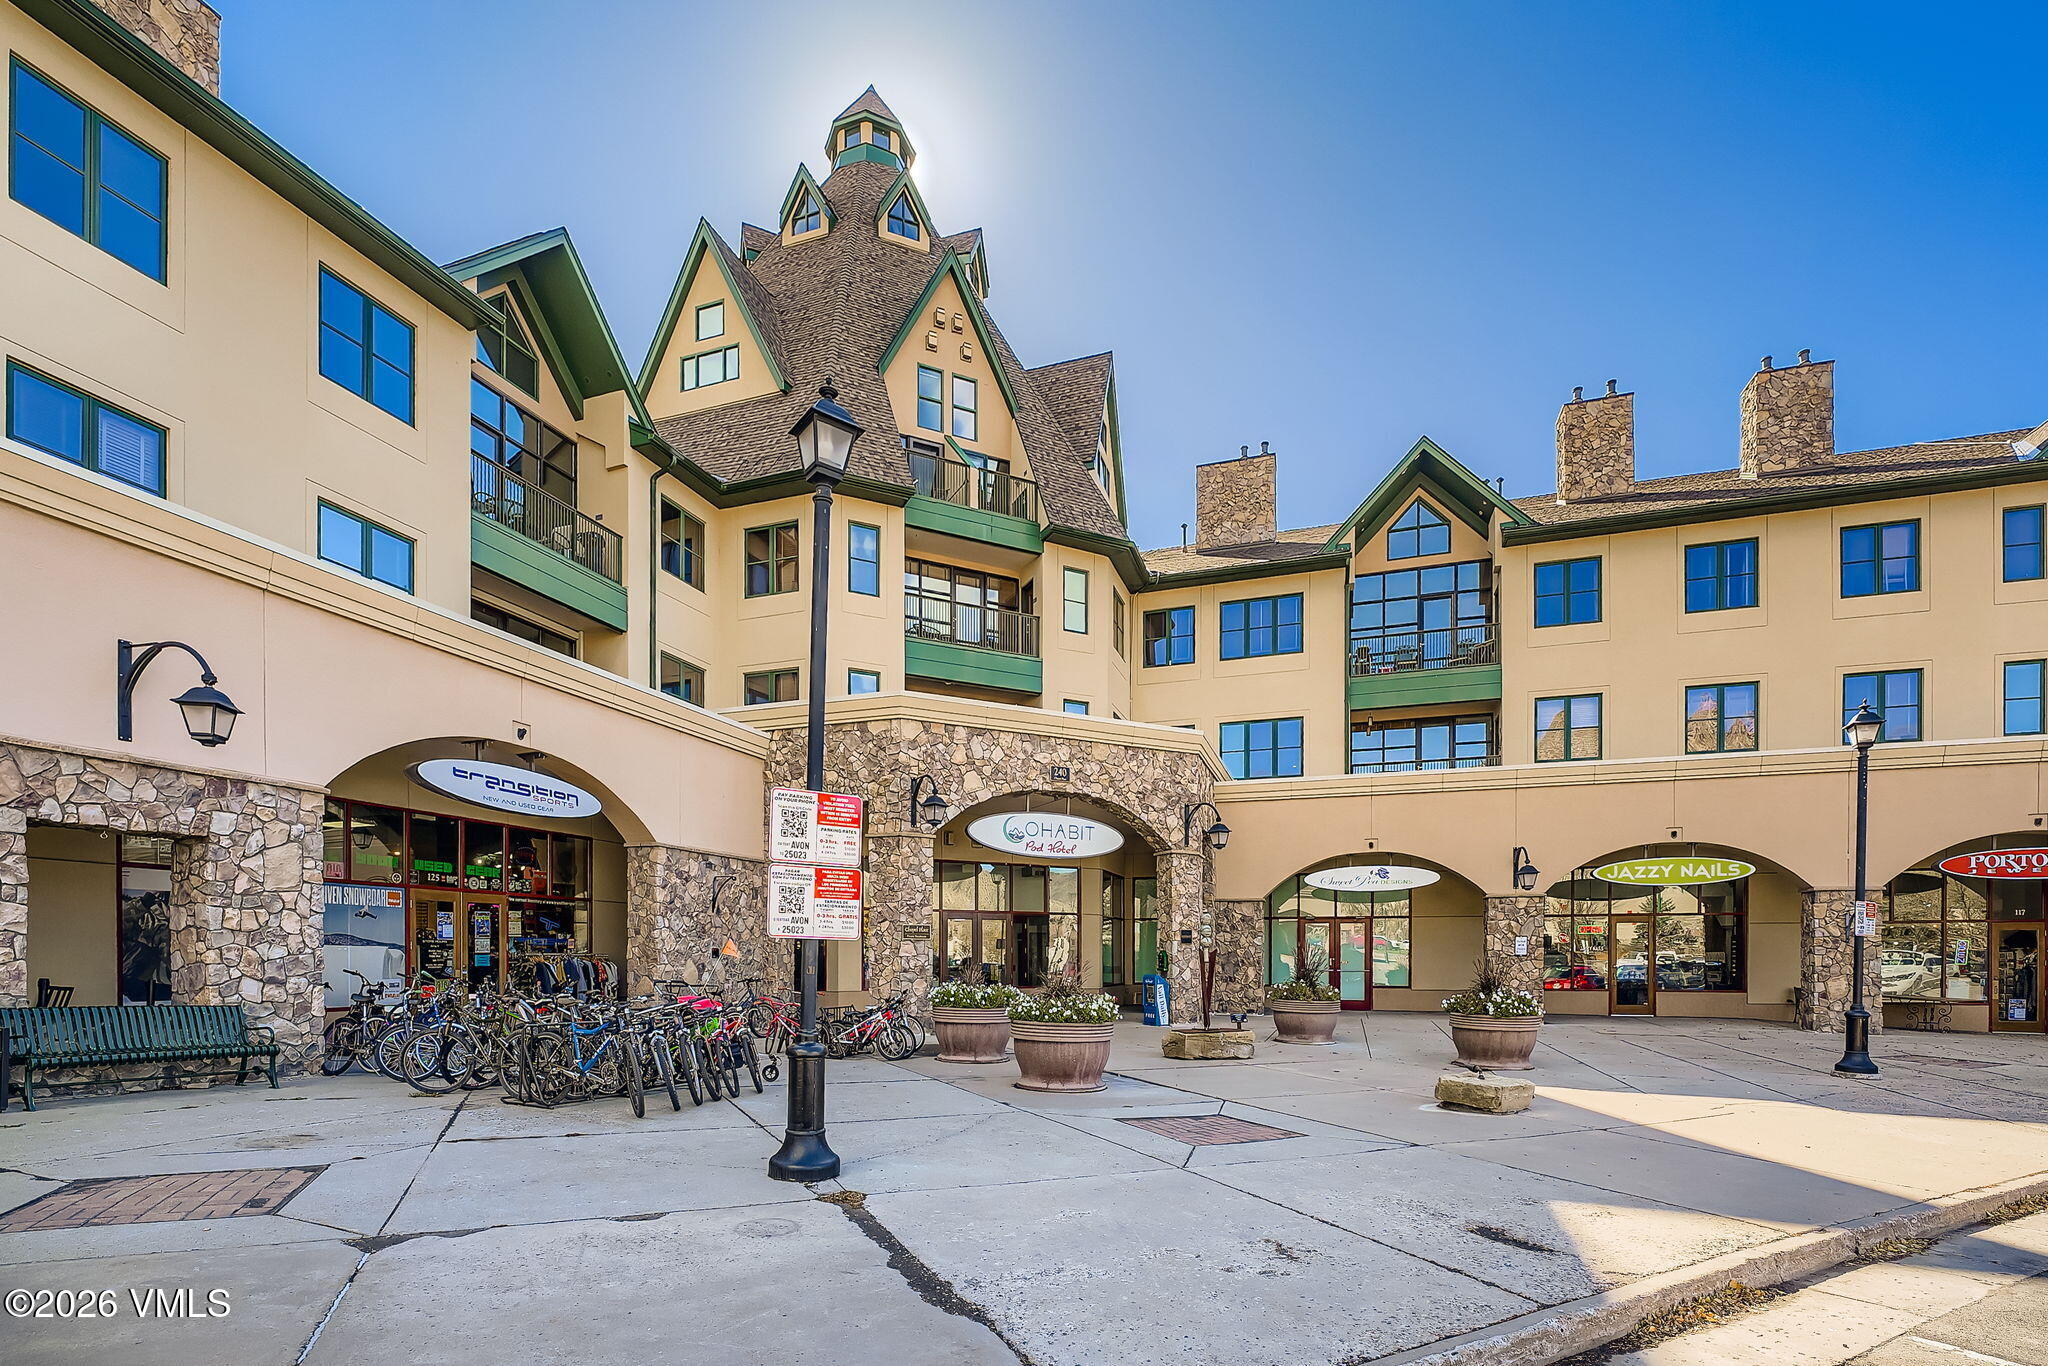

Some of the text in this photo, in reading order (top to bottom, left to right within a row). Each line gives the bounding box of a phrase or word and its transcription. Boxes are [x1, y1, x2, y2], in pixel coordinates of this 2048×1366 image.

[452, 766, 579, 807] transition
[483, 795, 500, 803] NEW
[518, 802, 536, 810] USED
[533, 795, 575, 809] SPORTS
[790, 841, 810, 850] AVON
[1025, 841, 1077, 854] Pod Hotel
[784, 850, 807, 860] 25023
[1968, 853, 2048, 870] PORTO
[414, 859, 453, 873] USED
[465, 865, 501, 878] GEAR
[1606, 863, 1741, 880] JAZZY NAILS
[1320, 876, 1353, 886] Sweet
[325, 886, 342, 904] IVEN
[344, 886, 402, 908] SNOWBOAR
[790, 916, 809, 924] AVON
[782, 926, 804, 934] 25023
